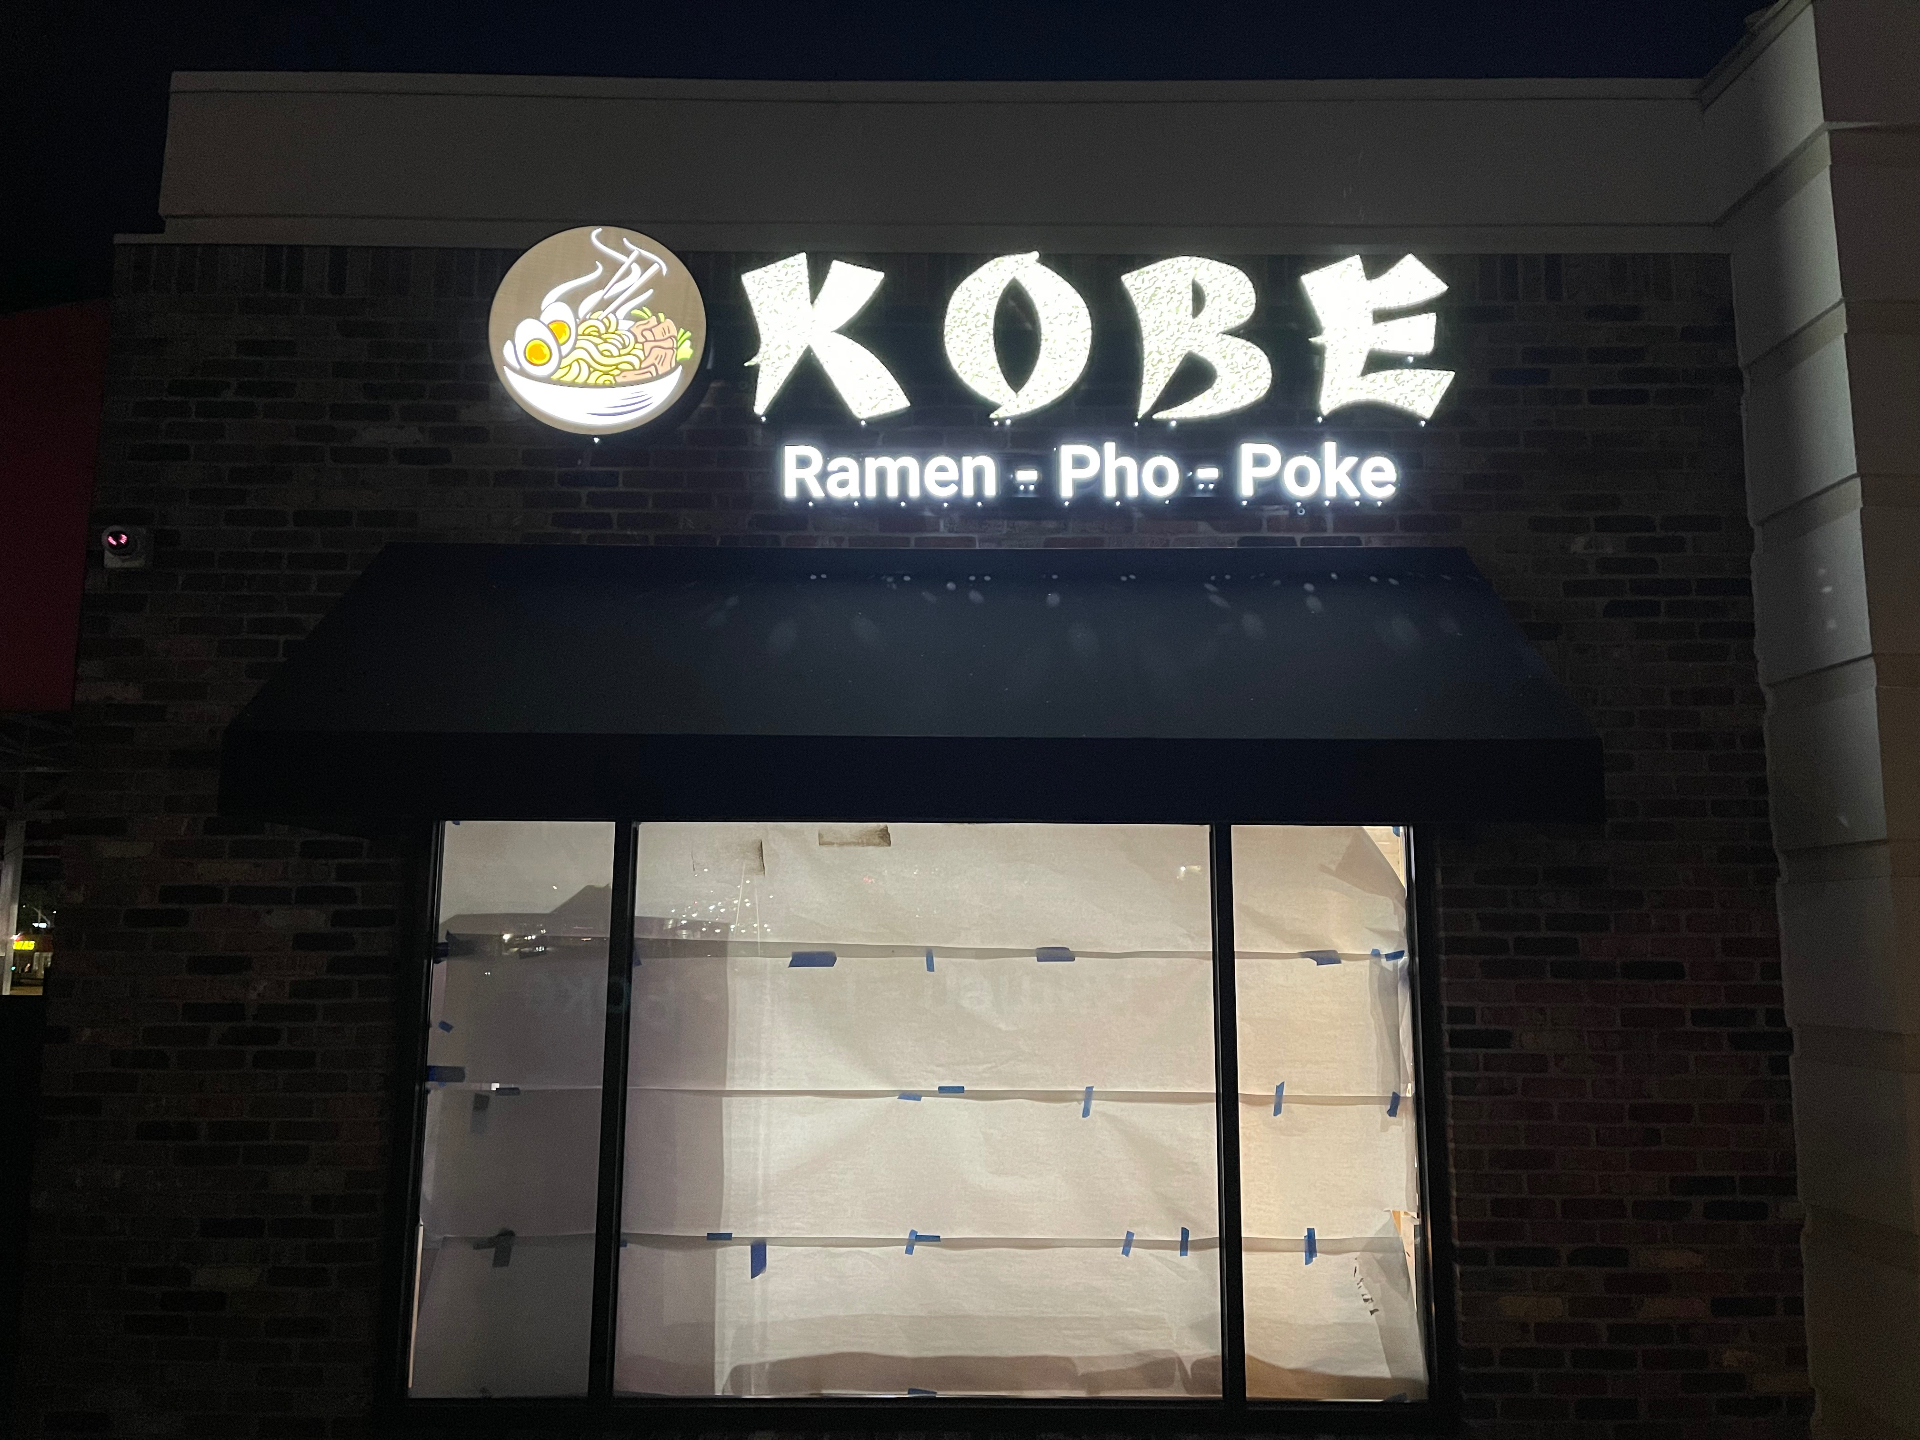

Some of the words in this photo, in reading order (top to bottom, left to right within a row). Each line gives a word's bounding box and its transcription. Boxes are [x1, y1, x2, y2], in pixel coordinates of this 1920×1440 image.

[741, 251, 1455, 420] KOBE
[783, 444, 998, 499] Ramen
[1059, 441, 1180, 499] Pho
[1239, 441, 1398, 500] Poke
